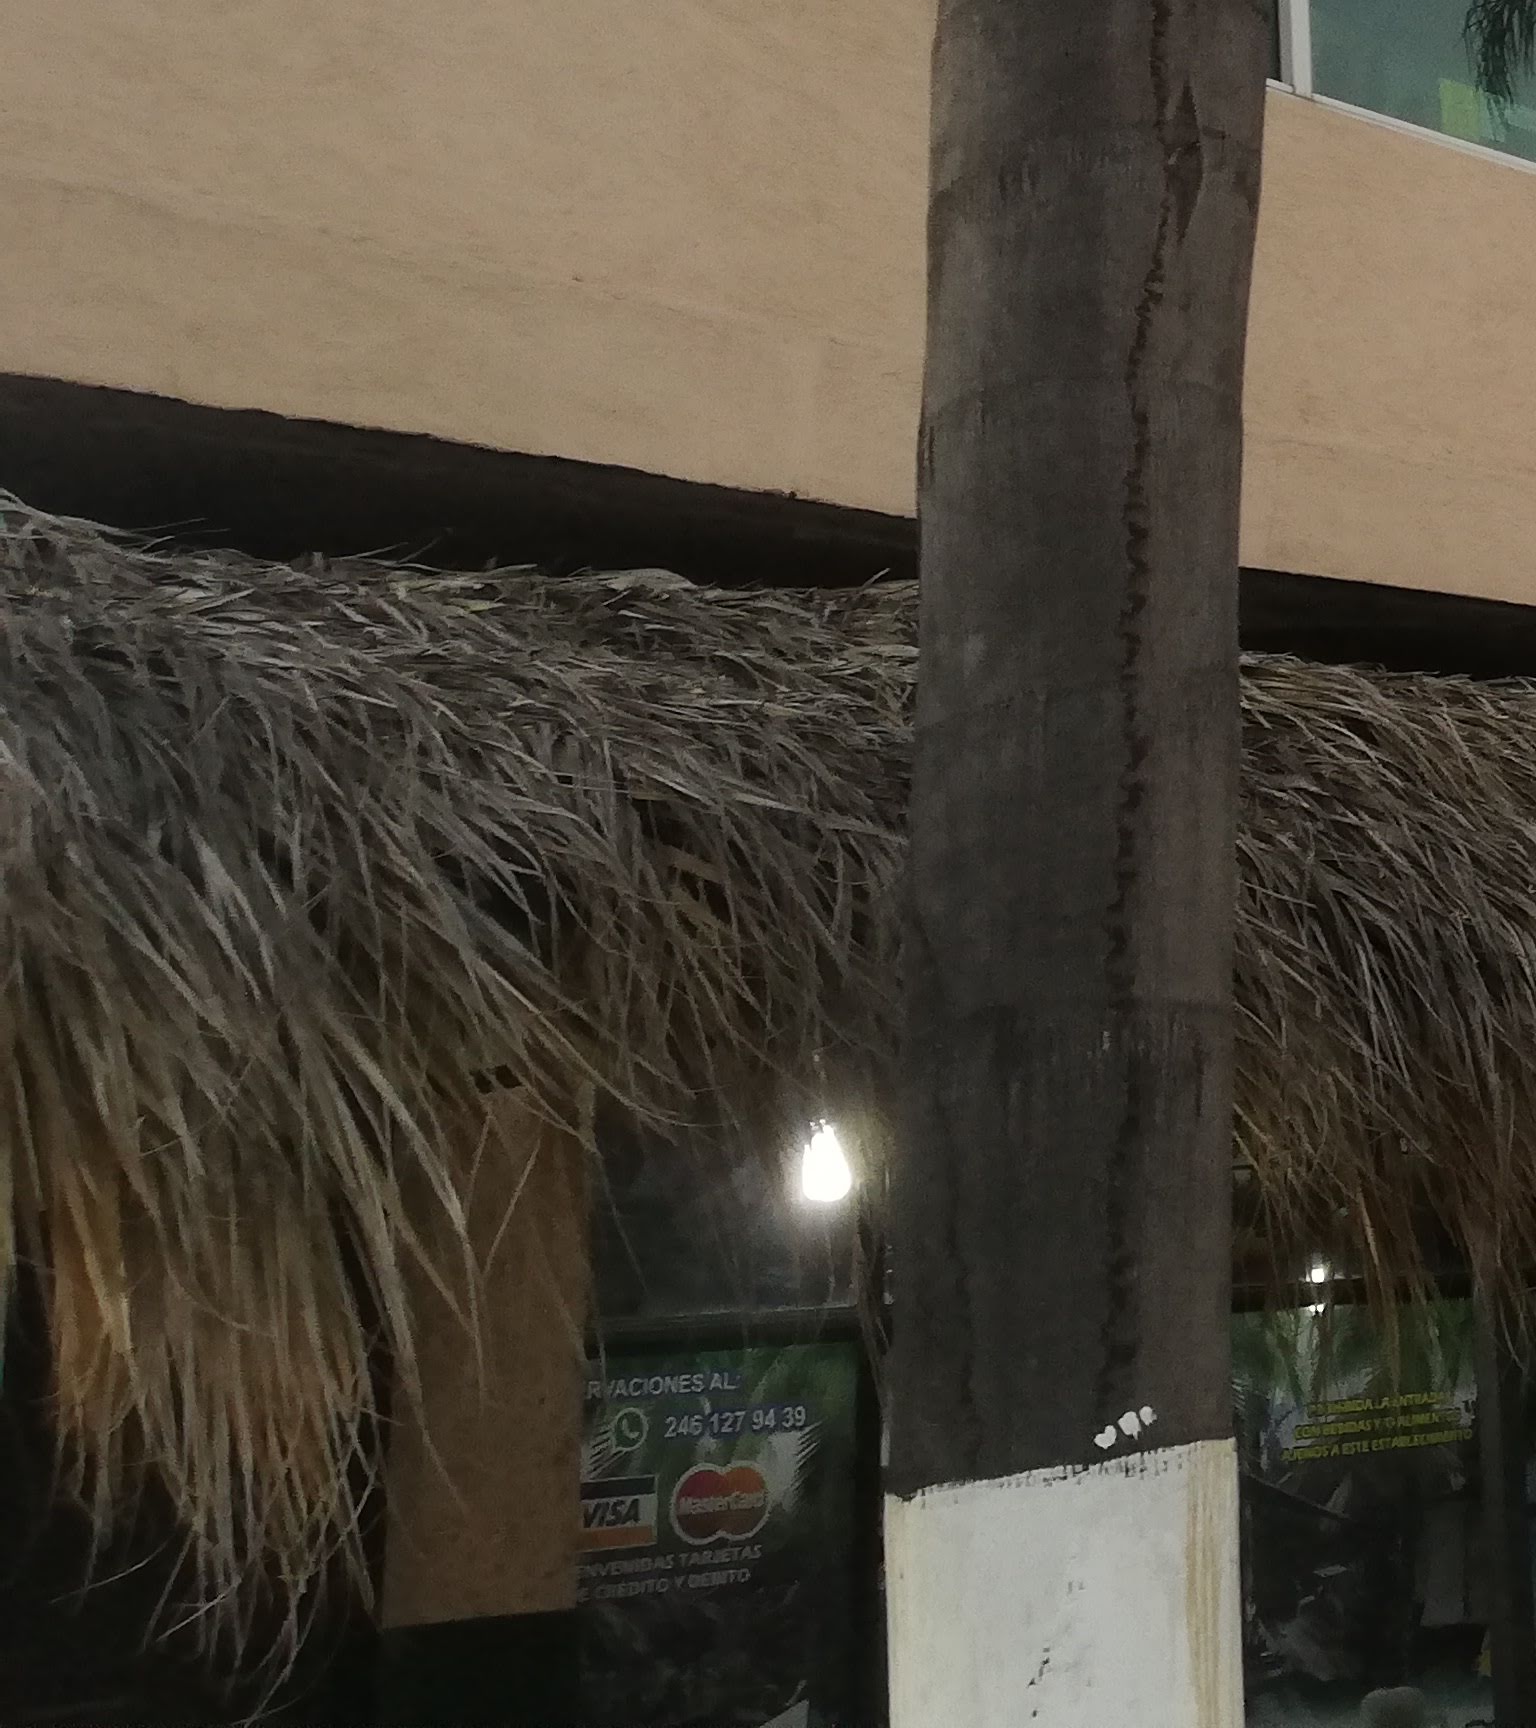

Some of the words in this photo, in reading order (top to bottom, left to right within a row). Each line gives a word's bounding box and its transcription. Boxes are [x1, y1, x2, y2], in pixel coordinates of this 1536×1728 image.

[664, 1415, 703, 1439] 246
[709, 1410, 744, 1434] 127
[752, 1407, 776, 1431] 94
[782, 1405, 807, 1429] 39
[583, 1498, 641, 1529] VISA
[577, 1555, 674, 1578] ENVENIDAS
[678, 1545, 762, 1566] TARJETAS
